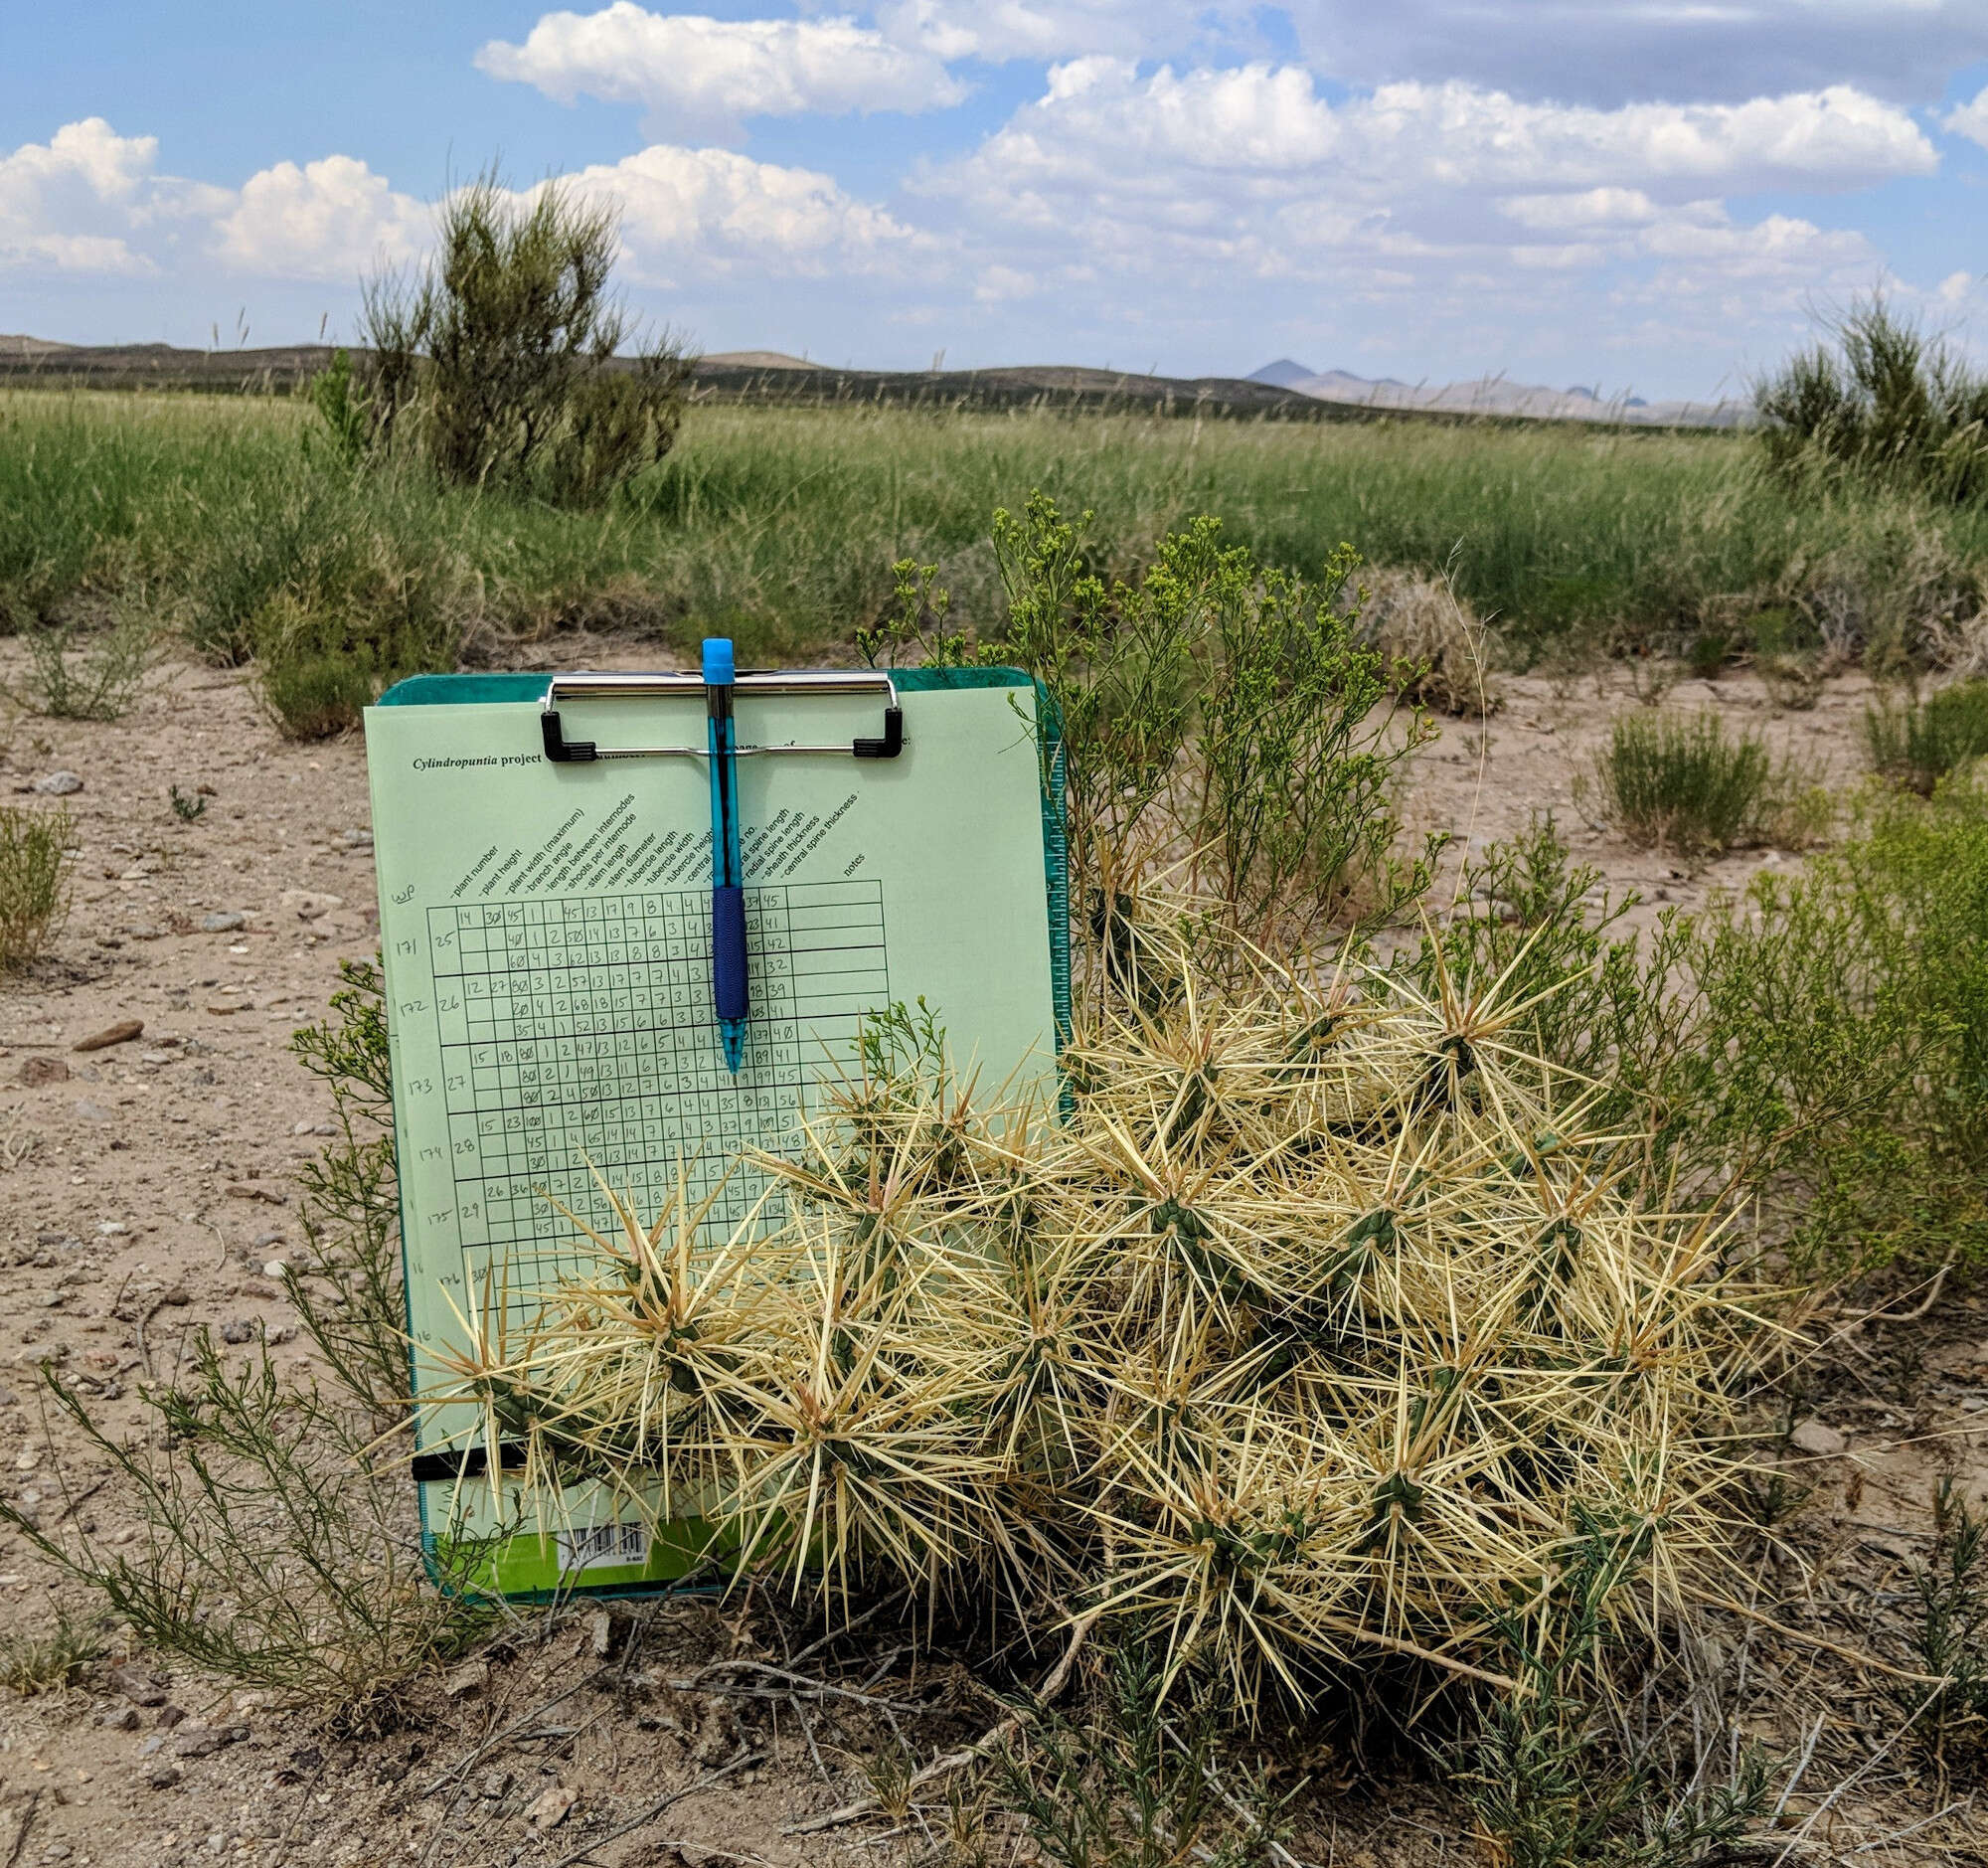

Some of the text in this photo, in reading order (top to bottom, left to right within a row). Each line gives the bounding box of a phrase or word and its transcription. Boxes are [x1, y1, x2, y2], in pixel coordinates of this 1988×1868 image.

[414, 753, 542, 771] Cylindropuntia project
[571, 833, 599, 866] between
[597, 792, 635, 834] internodes
[749, 807, 789, 854] spine length
[765, 836, 784, 857] spine
[782, 811, 805, 836] length
[787, 815, 820, 852] thickness
[807, 829, 826, 850] spine
[824, 793, 858, 830] thickness
[527, 851, 546, 873] width
[544, 807, 584, 853] (maximum)
[592, 848, 604, 865] per
[604, 812, 636, 850] internode
[625, 832, 656, 868] diameter
[656, 830, 679, 858] length
[675, 831, 695, 855] width
[471, 845, 498, 878] number
[499, 848, 523, 875] height
[553, 841, 574, 869] angle
[605, 843, 629, 869] length
[843, 853, 866, 877] notes
[435, 931, 455, 947] 25
[401, 995, 460, 1017] 172 26
[409, 1076, 466, 1096] 173 27
[455, 1138, 475, 1154] 28
[462, 1203, 478, 1219] 29
